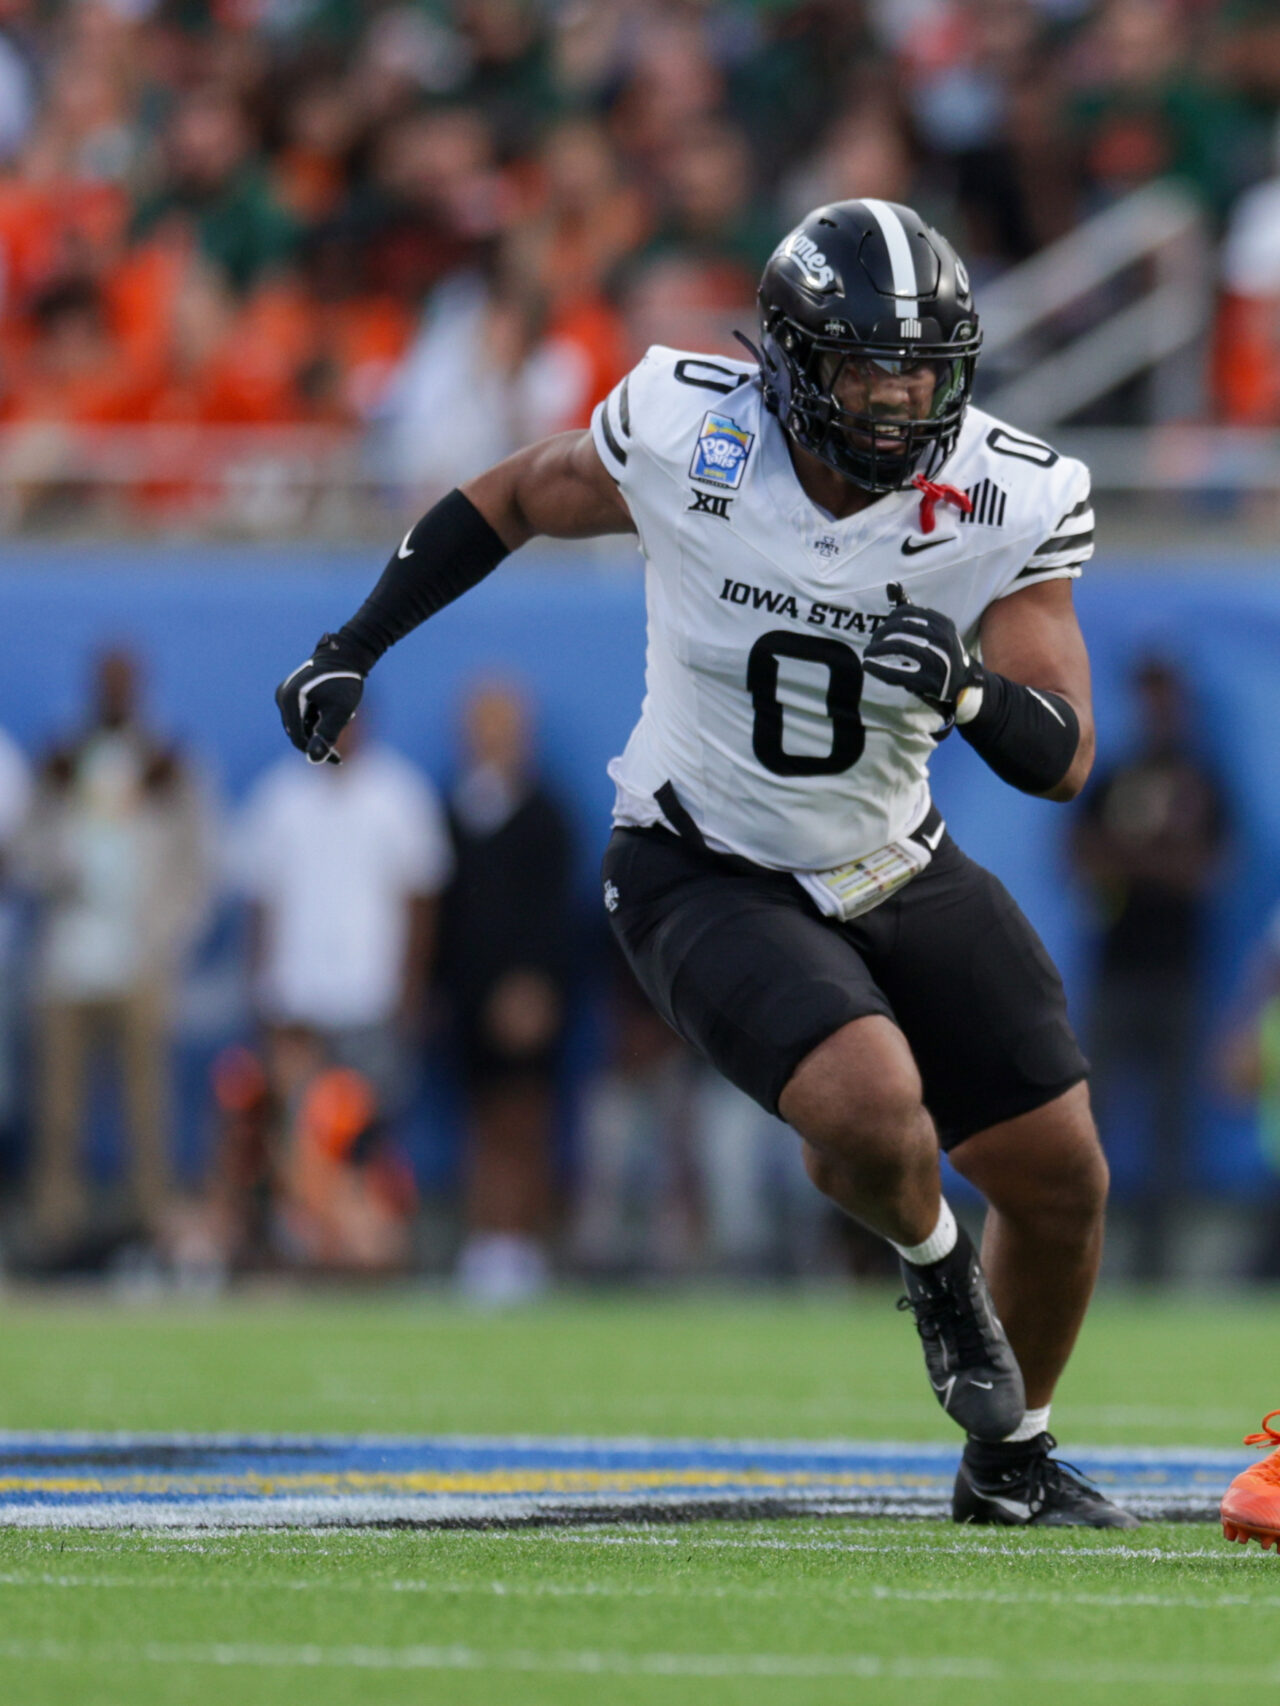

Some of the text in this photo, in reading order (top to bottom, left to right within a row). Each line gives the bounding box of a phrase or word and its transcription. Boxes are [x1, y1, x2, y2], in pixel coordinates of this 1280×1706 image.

[985, 427, 1060, 469] 0
[687, 487, 734, 521] XII
[719, 578, 892, 635] IOWA STAT
[746, 629, 867, 777] 0
